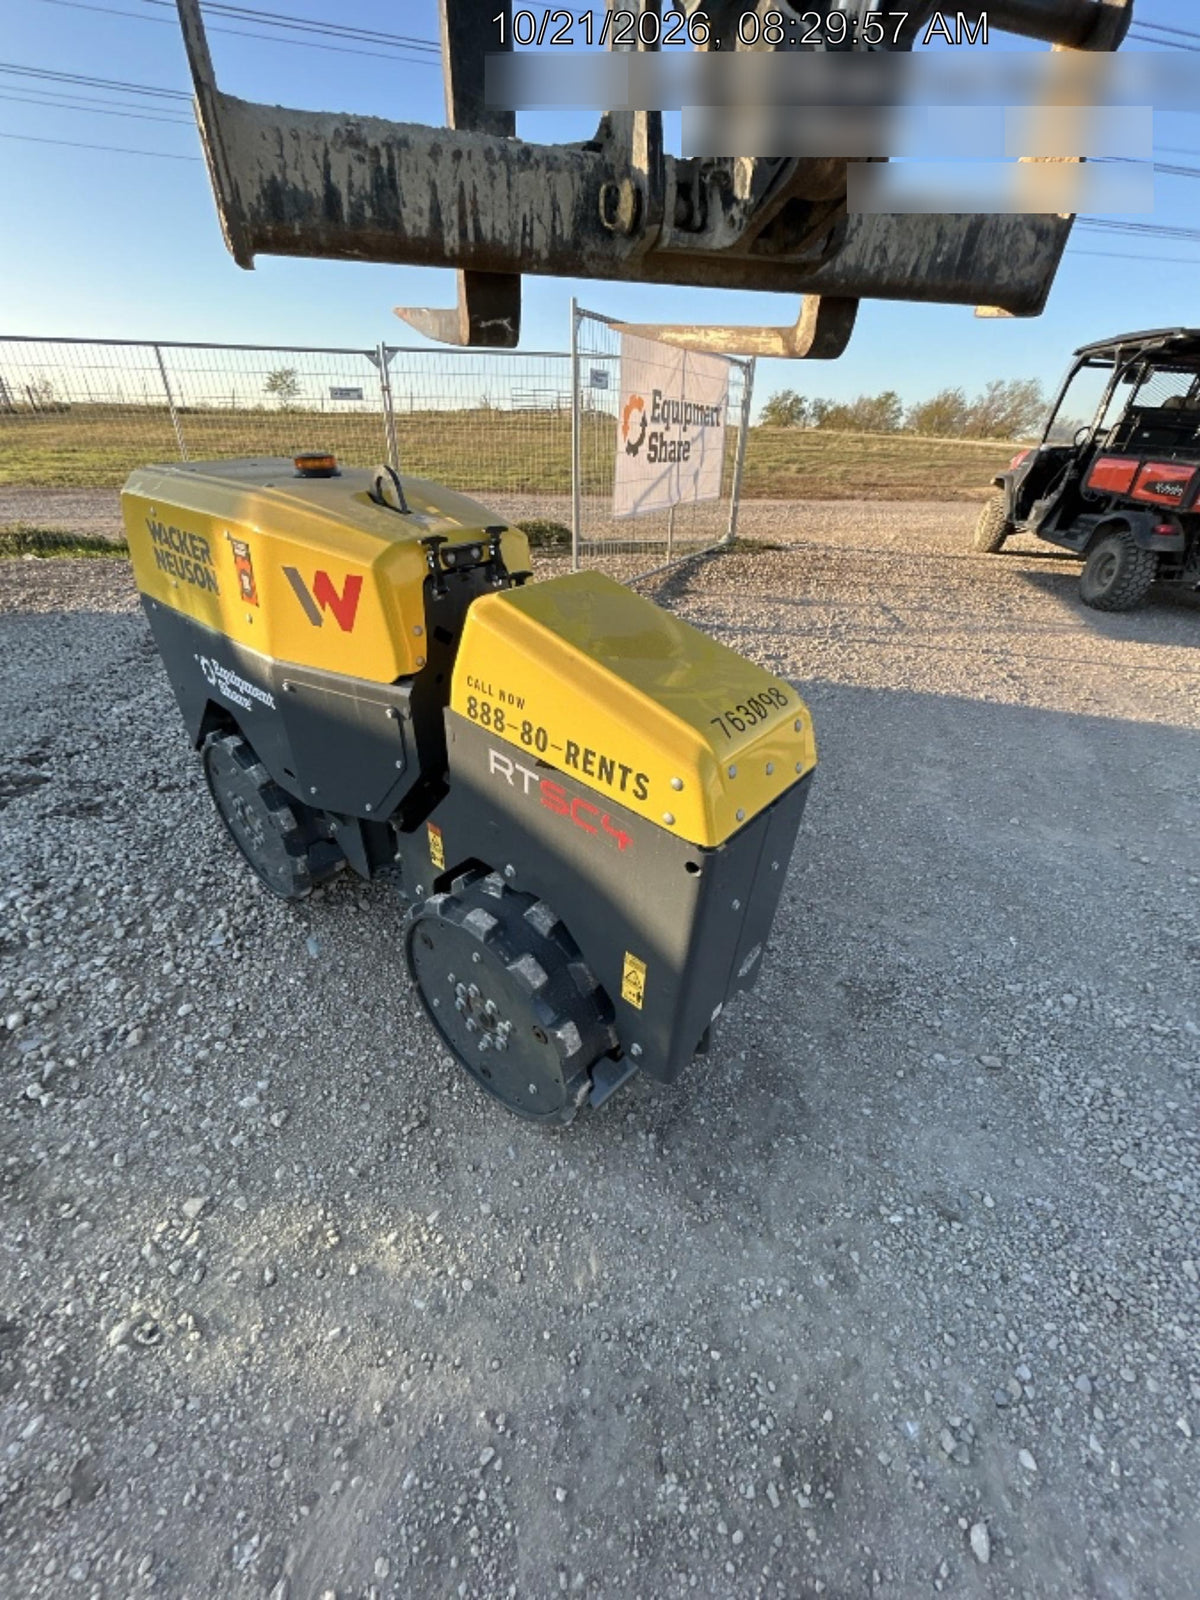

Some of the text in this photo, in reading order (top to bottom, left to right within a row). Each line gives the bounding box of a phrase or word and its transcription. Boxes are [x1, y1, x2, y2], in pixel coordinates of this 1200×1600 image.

[646, 431, 691, 464] Share
[146, 518, 214, 566] WACKER
[153, 546, 220, 596] NEUSON
[466, 674, 526, 711] CALL NOW
[466, 695, 650, 802] 888-80-RENTS
